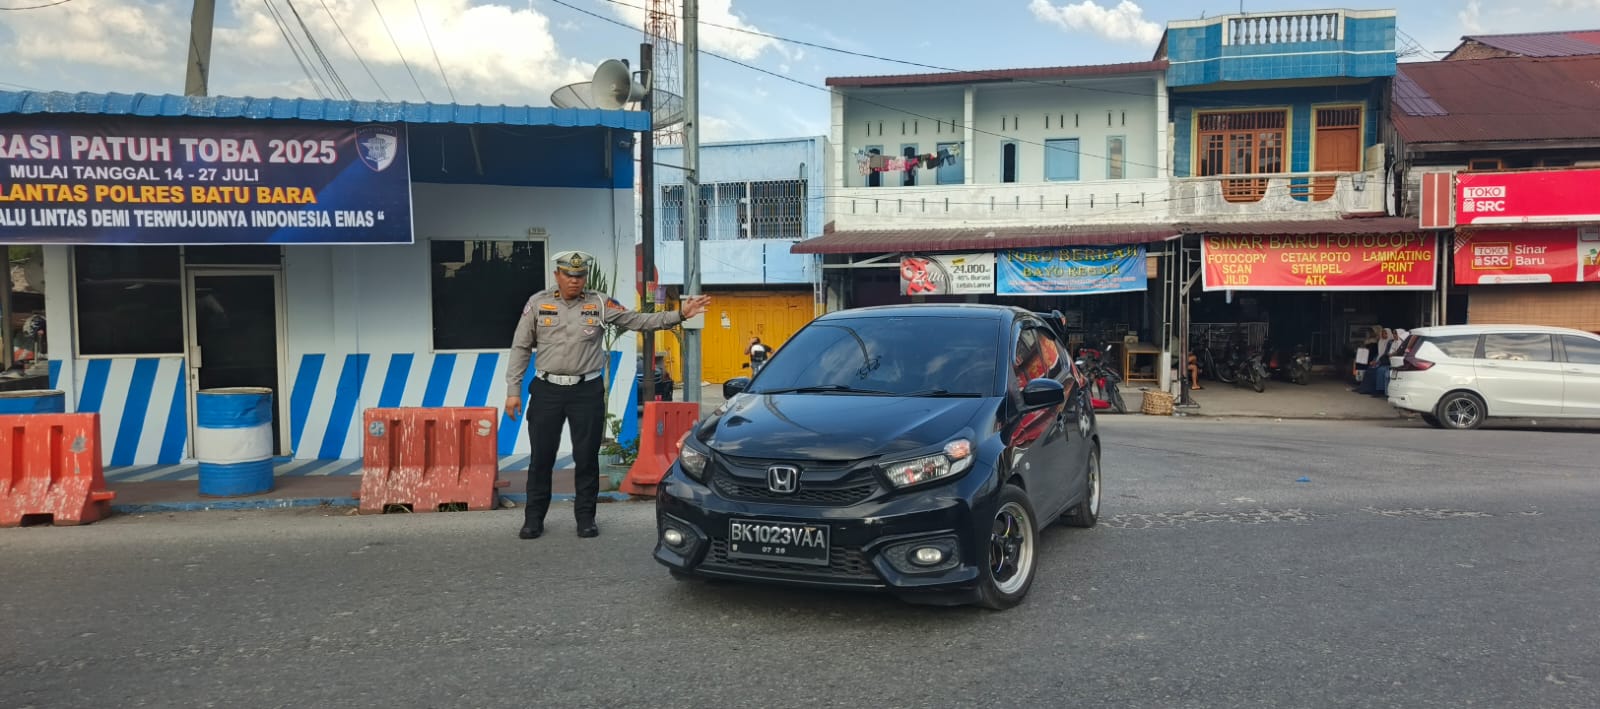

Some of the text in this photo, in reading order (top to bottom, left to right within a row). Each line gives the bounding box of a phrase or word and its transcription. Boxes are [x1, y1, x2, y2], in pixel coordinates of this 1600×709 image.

[70, 135, 172, 163] PATUH
[179, 137, 262, 164] TOBA
[268, 139, 337, 164] 2025
[10, 164, 68, 179] MULAI
[73, 165, 160, 181] TANGGAL
[164, 168, 184, 181] 14
[198, 168, 217, 181] 27
[222, 168, 259, 182] JULI
[95, 185, 185, 203] POLRES
[191, 185, 249, 204] BATU
[257, 186, 317, 204] BARA
[1468, 187, 1501, 197] TOKO
[1476, 200, 1505, 212] SRC
[31, 208, 88, 227] LINTAS
[91, 209, 130, 227] DEMI
[134, 209, 248, 228] TERWUJUDNYA
[251, 209, 332, 228] INDONESIA
[334, 210, 375, 227] EMAS
[1210, 232, 1428, 250] SINAR BARU FOTOCOPY
[1514, 244, 1547, 254] Sinar
[1207, 253, 1267, 264] FOTOCOPY
[1280, 252, 1351, 263] CETAK POTO
[1362, 250, 1431, 262] LAMINATING
[1483, 256, 1509, 265] SRC
[1515, 256, 1545, 266] Baru
[1222, 264, 1252, 274] SCAN
[1291, 264, 1343, 274] STEMPEL
[1380, 262, 1414, 273] PRINT
[1223, 275, 1249, 285] JILID
[1305, 275, 1327, 285] ATK
[1386, 274, 1408, 285] DLL
